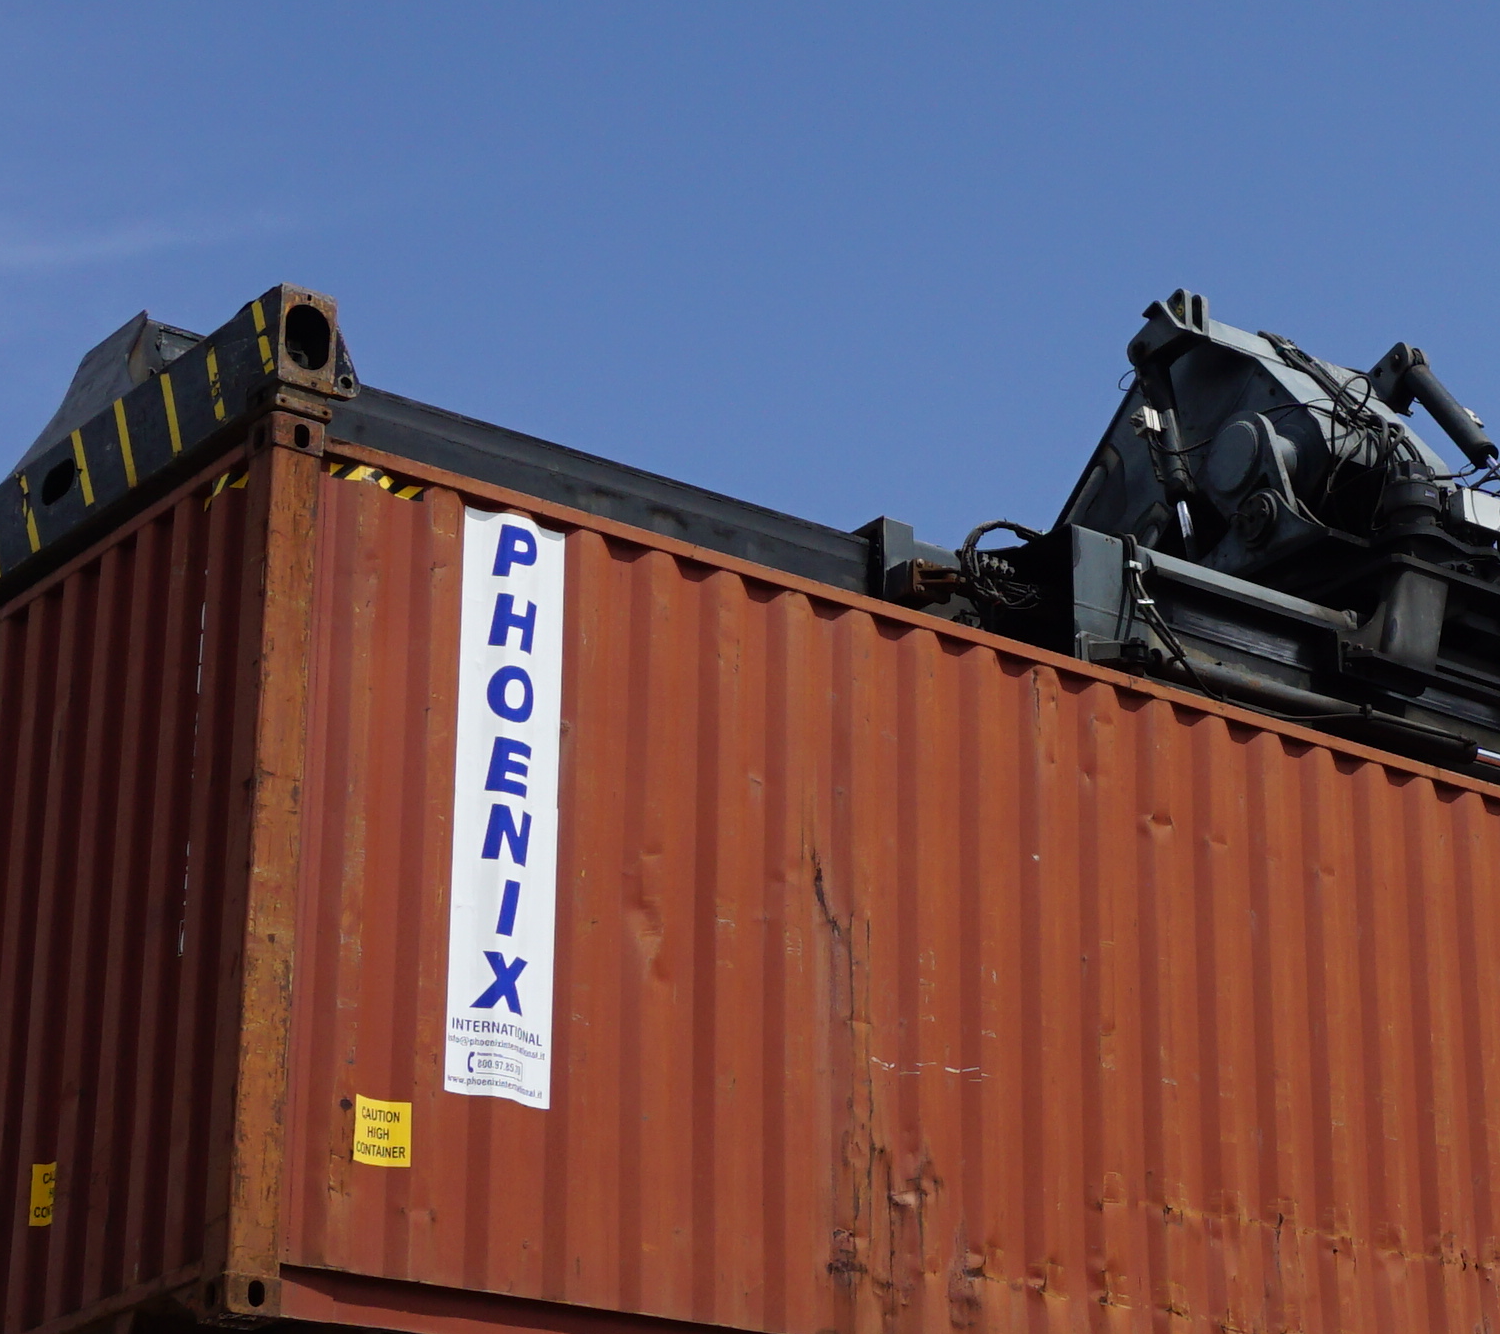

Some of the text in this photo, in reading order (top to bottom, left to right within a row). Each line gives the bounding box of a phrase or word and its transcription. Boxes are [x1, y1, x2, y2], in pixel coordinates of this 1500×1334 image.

[469, 523, 536, 1016] PHOENIX
[452, 1017, 543, 1046] INTERNATIONAL
[362, 1106, 400, 1123] CAUTION
[367, 1126, 389, 1140] HIGH
[356, 1141, 406, 1159] CONTAINER
